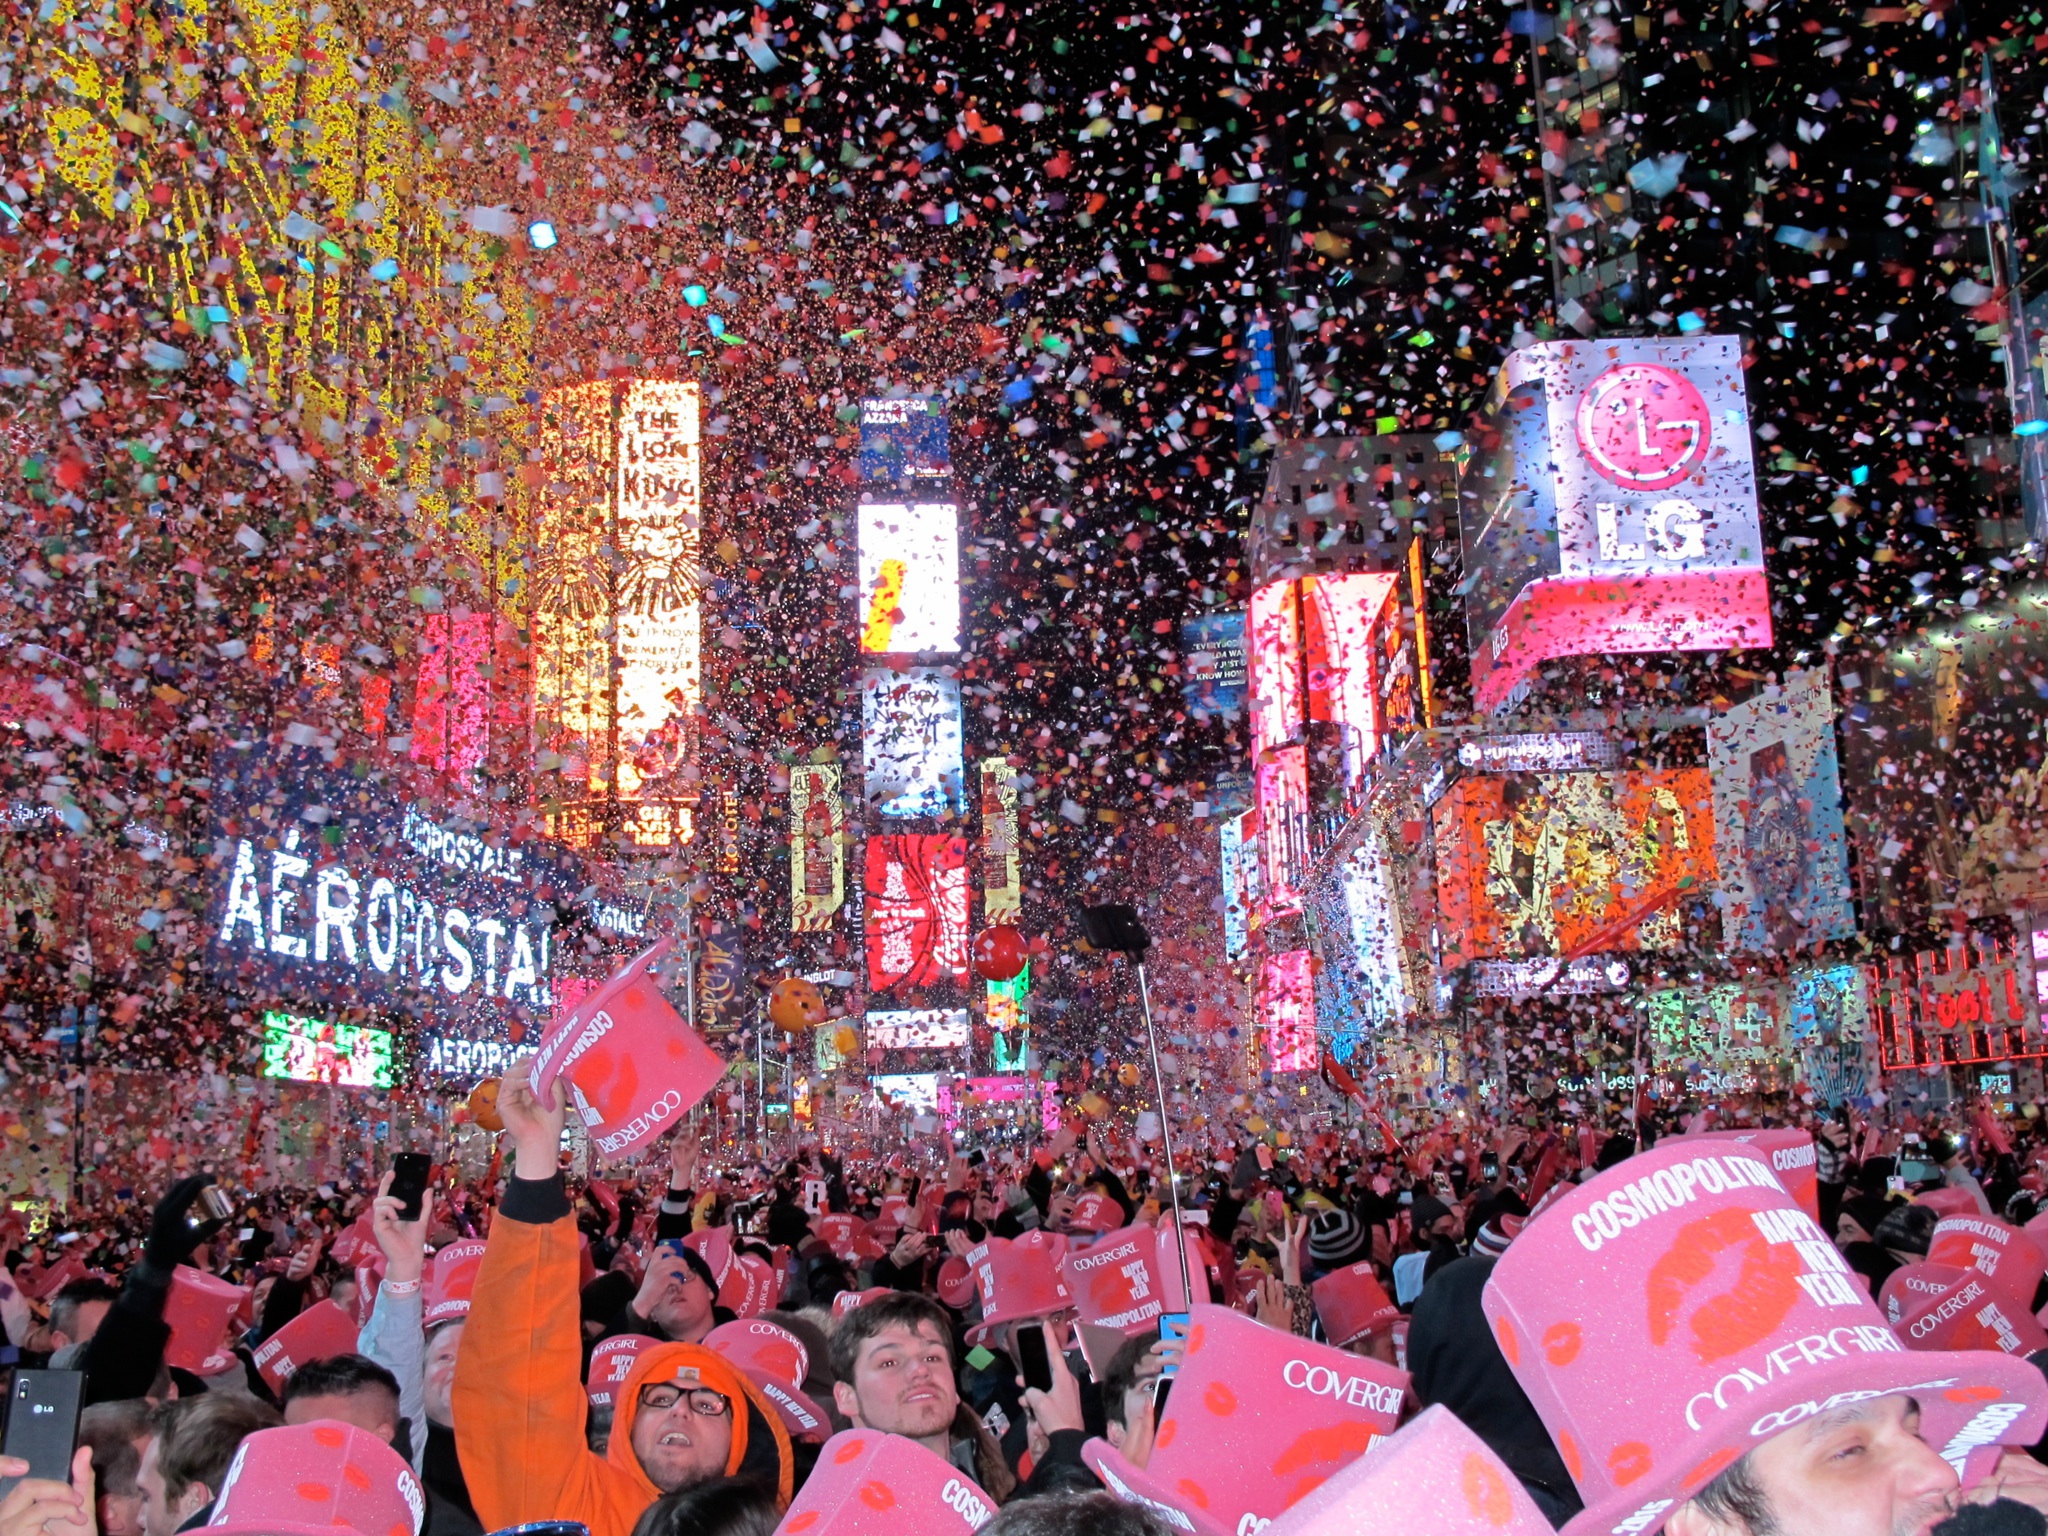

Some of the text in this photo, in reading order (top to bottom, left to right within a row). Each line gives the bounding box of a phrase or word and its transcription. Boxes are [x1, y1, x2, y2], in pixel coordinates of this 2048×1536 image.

[624, 468, 695, 502] KING
[1596, 499, 1706, 561] LG
[1196, 671, 1222, 680] KNOW
[1571, 1155, 1787, 1252] COSMOPOLITAN
[1750, 1209, 1826, 1245] HAPPY
[1073, 1241, 1140, 1272] COVERGIRL
[1793, 1238, 1850, 1275] NEW
[1970, 1242, 2001, 1265] HAPPY
[1121, 1258, 1146, 1279] HAPPY
[1131, 1269, 1149, 1287] NEW
[1975, 1258, 1997, 1278] NEW
[1129, 1283, 1151, 1301] YEAR
[1794, 1271, 1866, 1309] YEAR
[1909, 1280, 1986, 1339] COVERGIRL
[591, 1392, 611, 1404] YEAR
[763, 1383, 788, 1406] HAPPY
